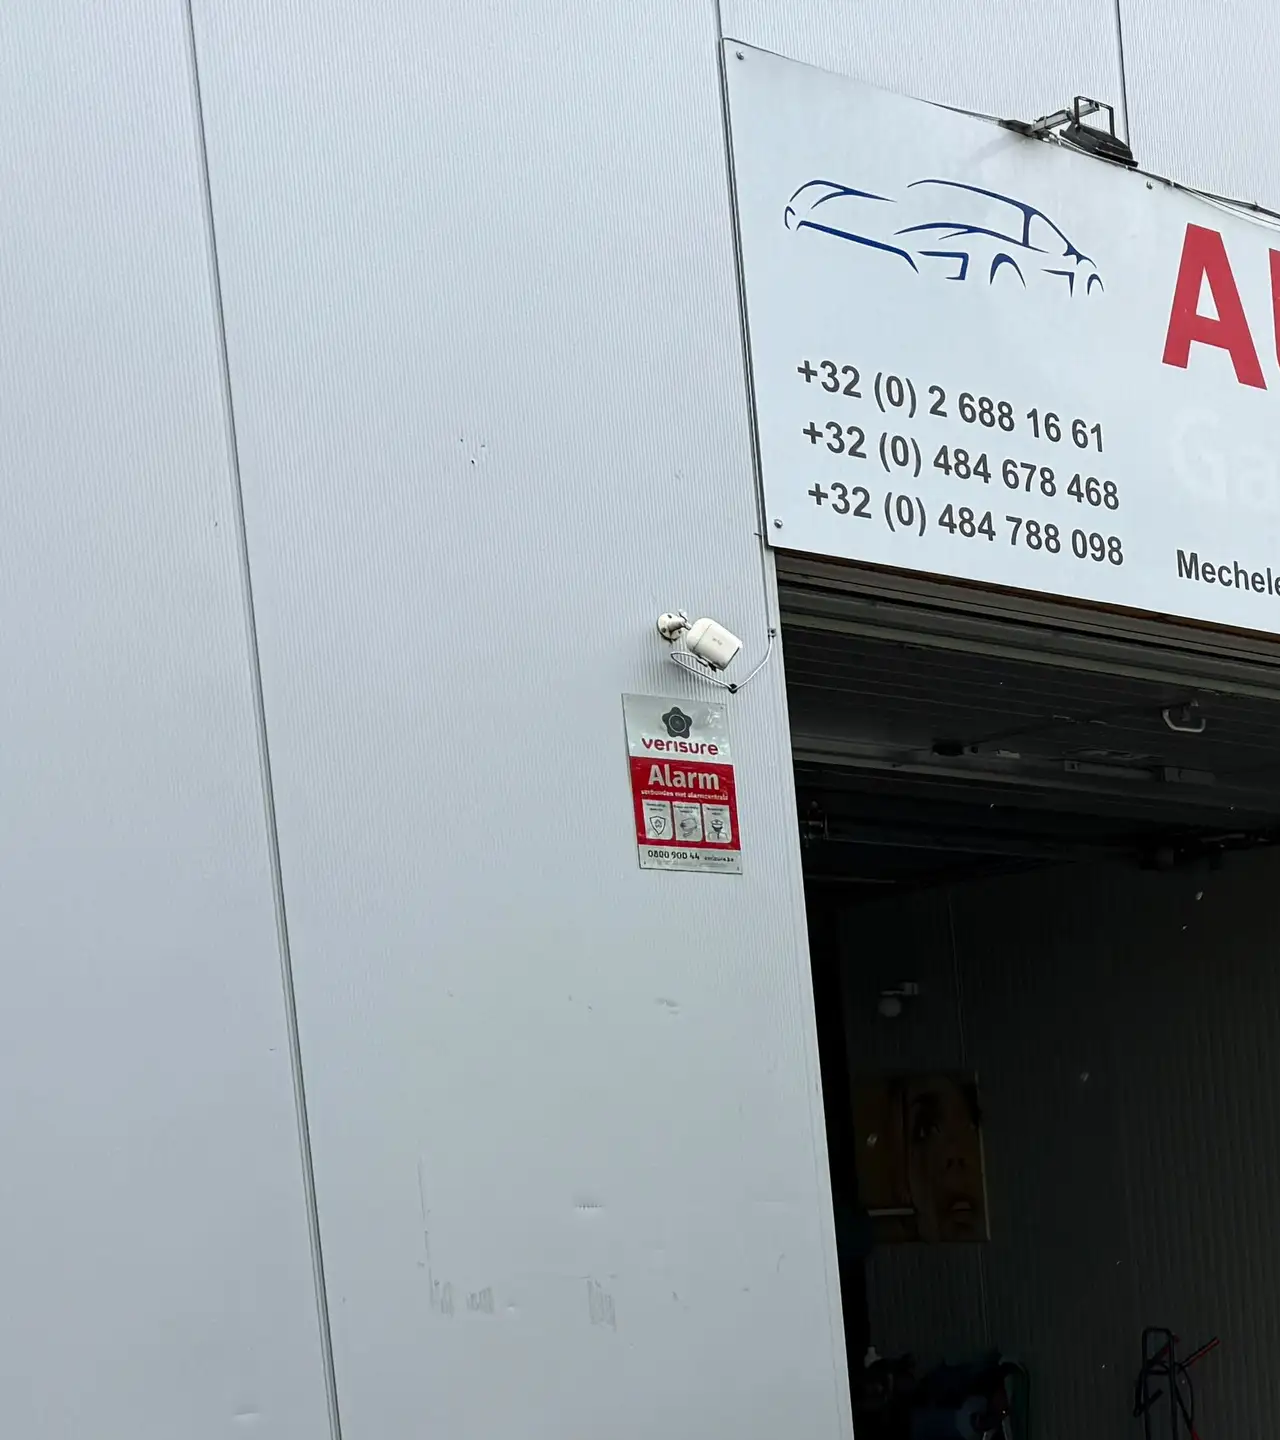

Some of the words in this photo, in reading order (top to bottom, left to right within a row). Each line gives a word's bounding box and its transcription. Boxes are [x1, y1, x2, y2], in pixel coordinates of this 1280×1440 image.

[798, 361, 861, 399] +32
[875, 372, 917, 419] (0)
[929, 386, 947, 417] 2
[959, 393, 1015, 432] 688
[1027, 409, 1061, 443] 16
[1072, 419, 1103, 453] 61
[803, 422, 867, 459] +32
[880, 433, 922, 478] (0)
[934, 445, 991, 484] 484
[1003, 459, 1057, 498] 678
[1067, 474, 1120, 511] 468
[808, 483, 871, 519] +32
[885, 492, 926, 537] (0)
[939, 503, 996, 542] 484
[1006, 516, 1061, 554] 788
[1072, 529, 1124, 567] 098
[641, 738, 718, 755] verisure
[648, 763, 720, 790] Alarm
[647, 849, 670, 859] 0800
